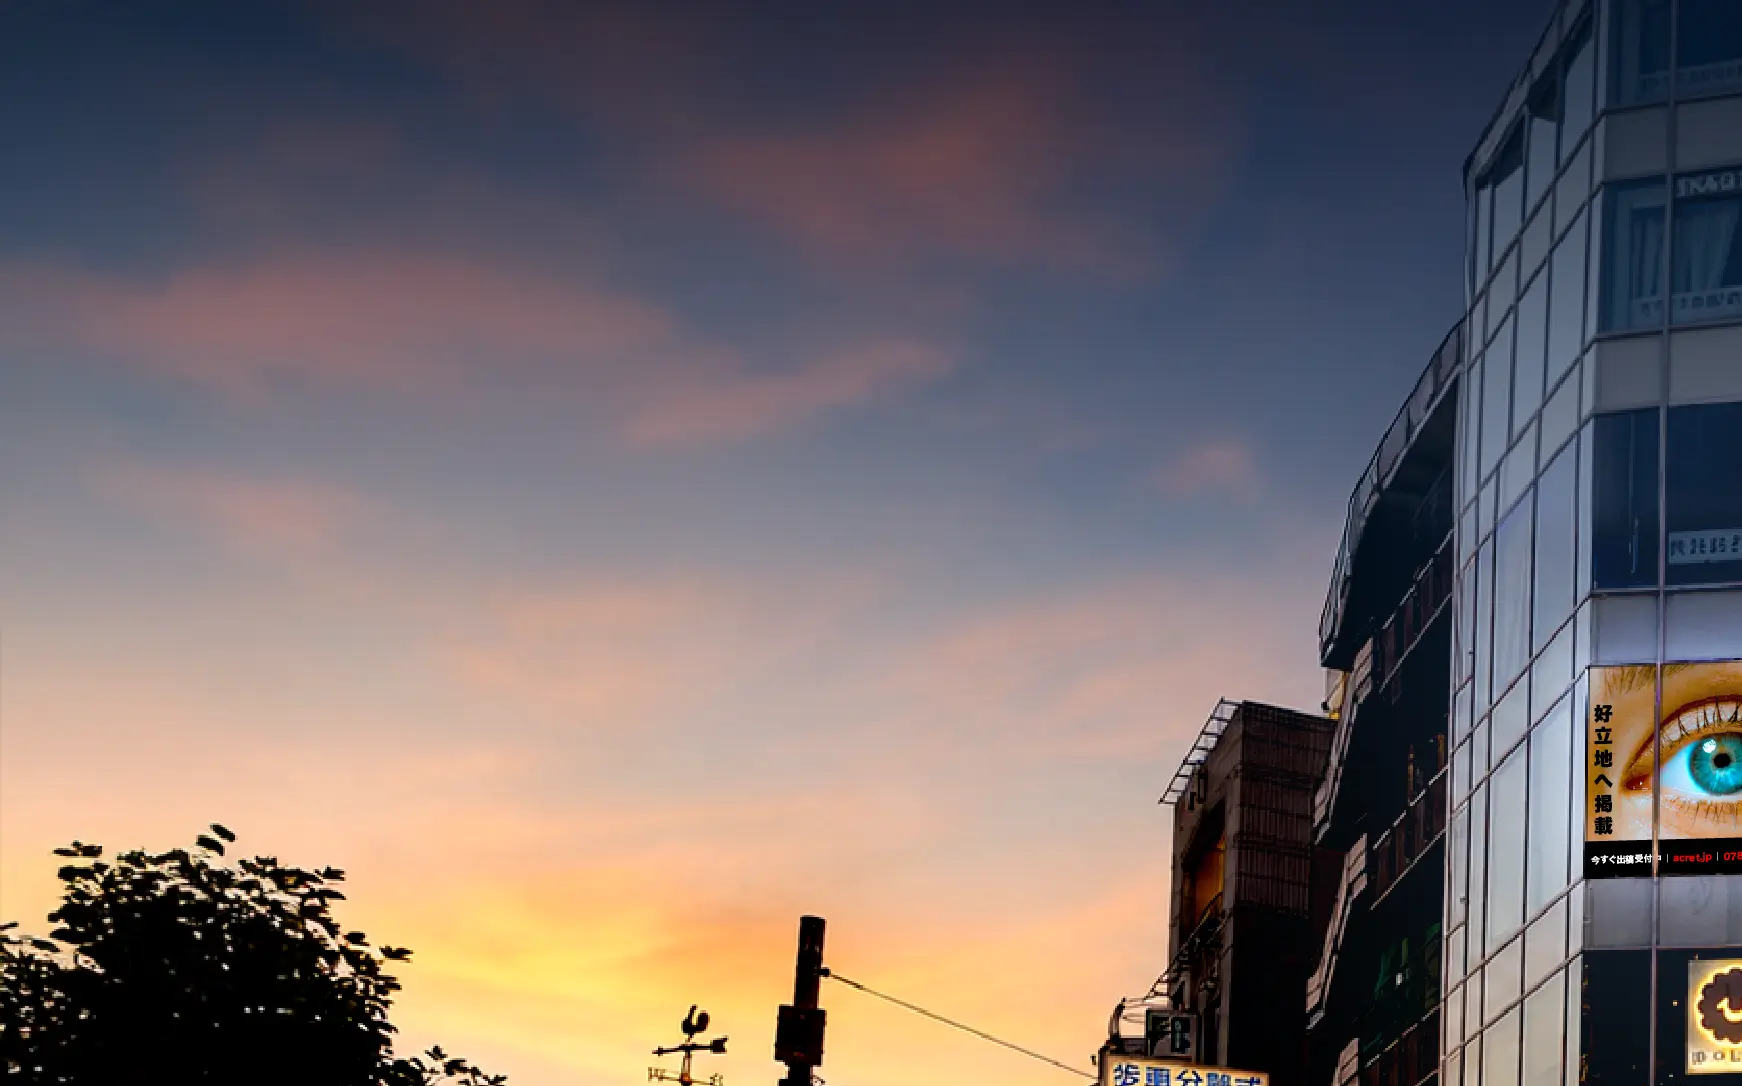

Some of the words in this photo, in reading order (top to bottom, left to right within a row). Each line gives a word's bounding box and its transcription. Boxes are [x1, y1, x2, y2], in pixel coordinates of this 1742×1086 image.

[1594, 704, 1613, 836] 好立地へ掲載
